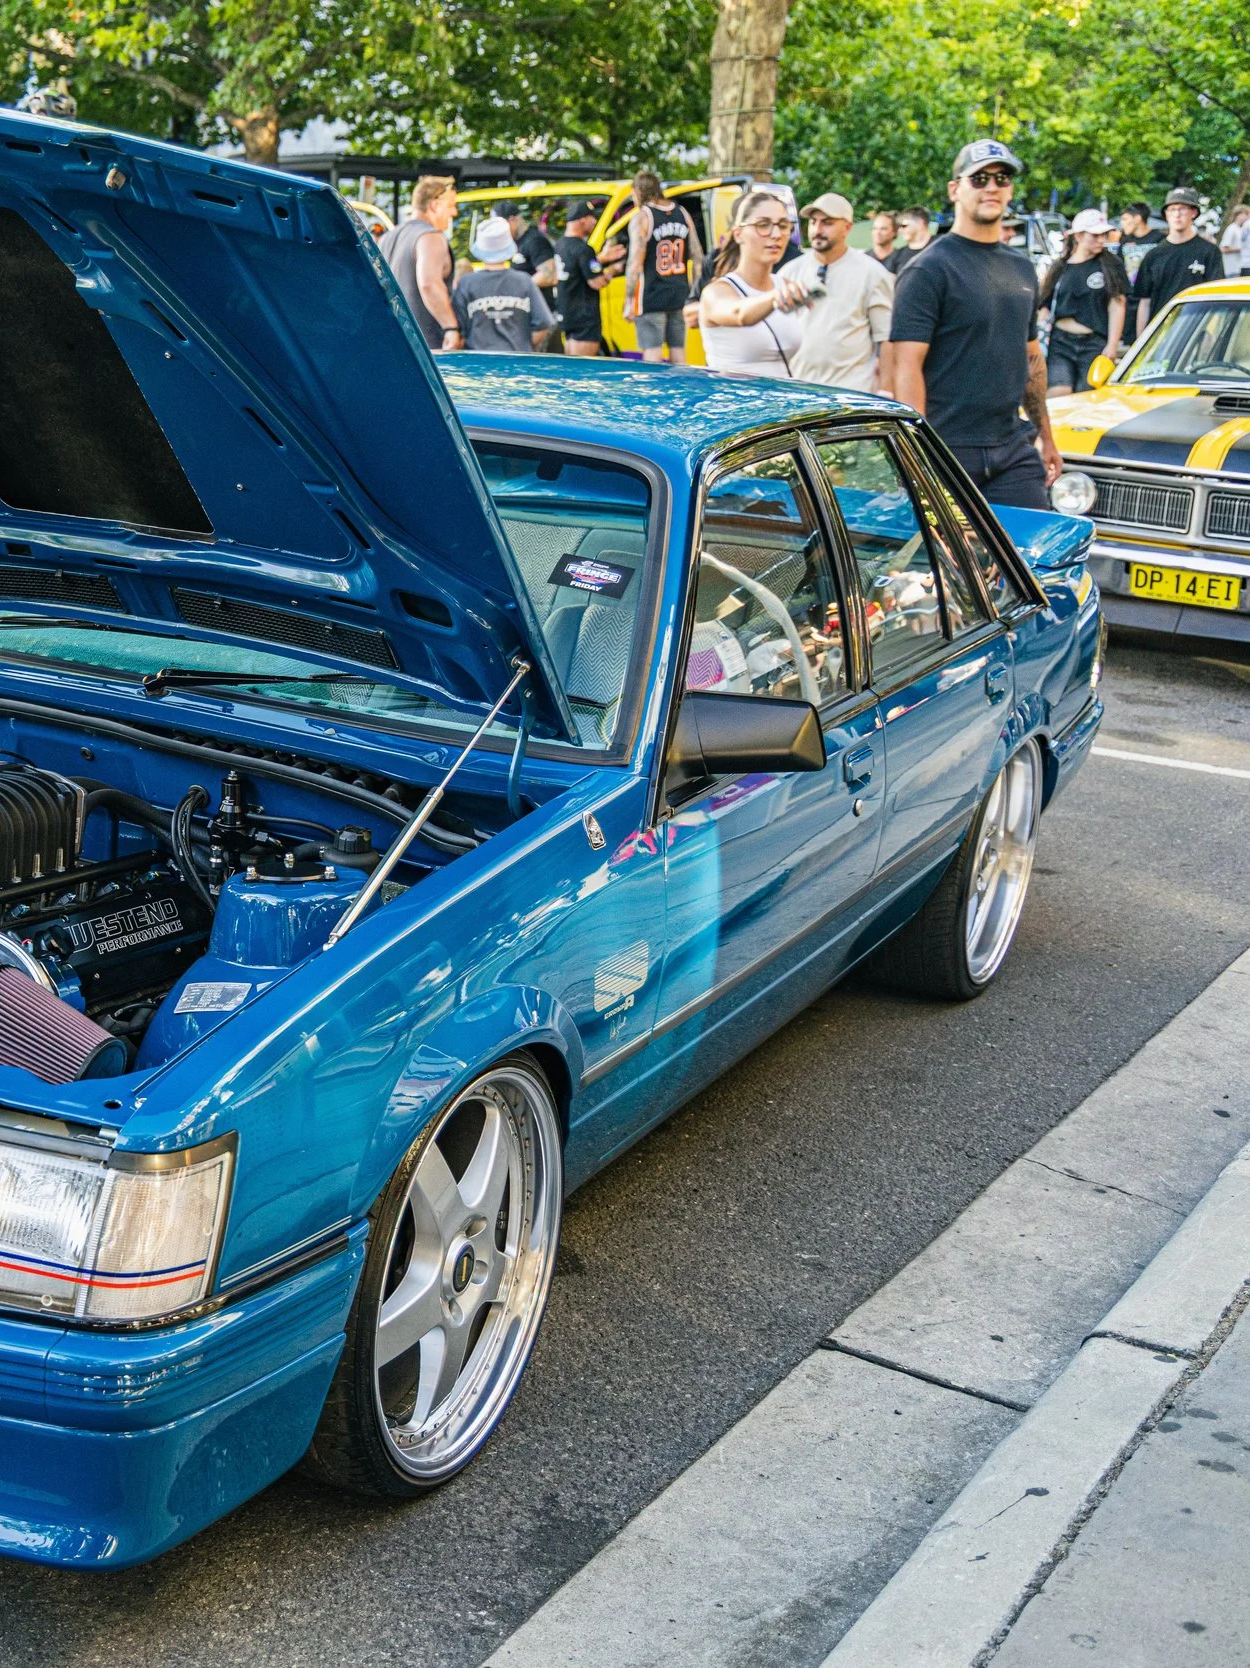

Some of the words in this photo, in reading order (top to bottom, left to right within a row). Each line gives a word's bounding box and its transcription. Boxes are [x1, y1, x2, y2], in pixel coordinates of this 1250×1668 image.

[656, 240, 686, 276] 81
[570, 581, 603, 592] FRIDAY
[63, 898, 179, 953] WESTEND
[96, 919, 184, 955] PERFORMANCE
